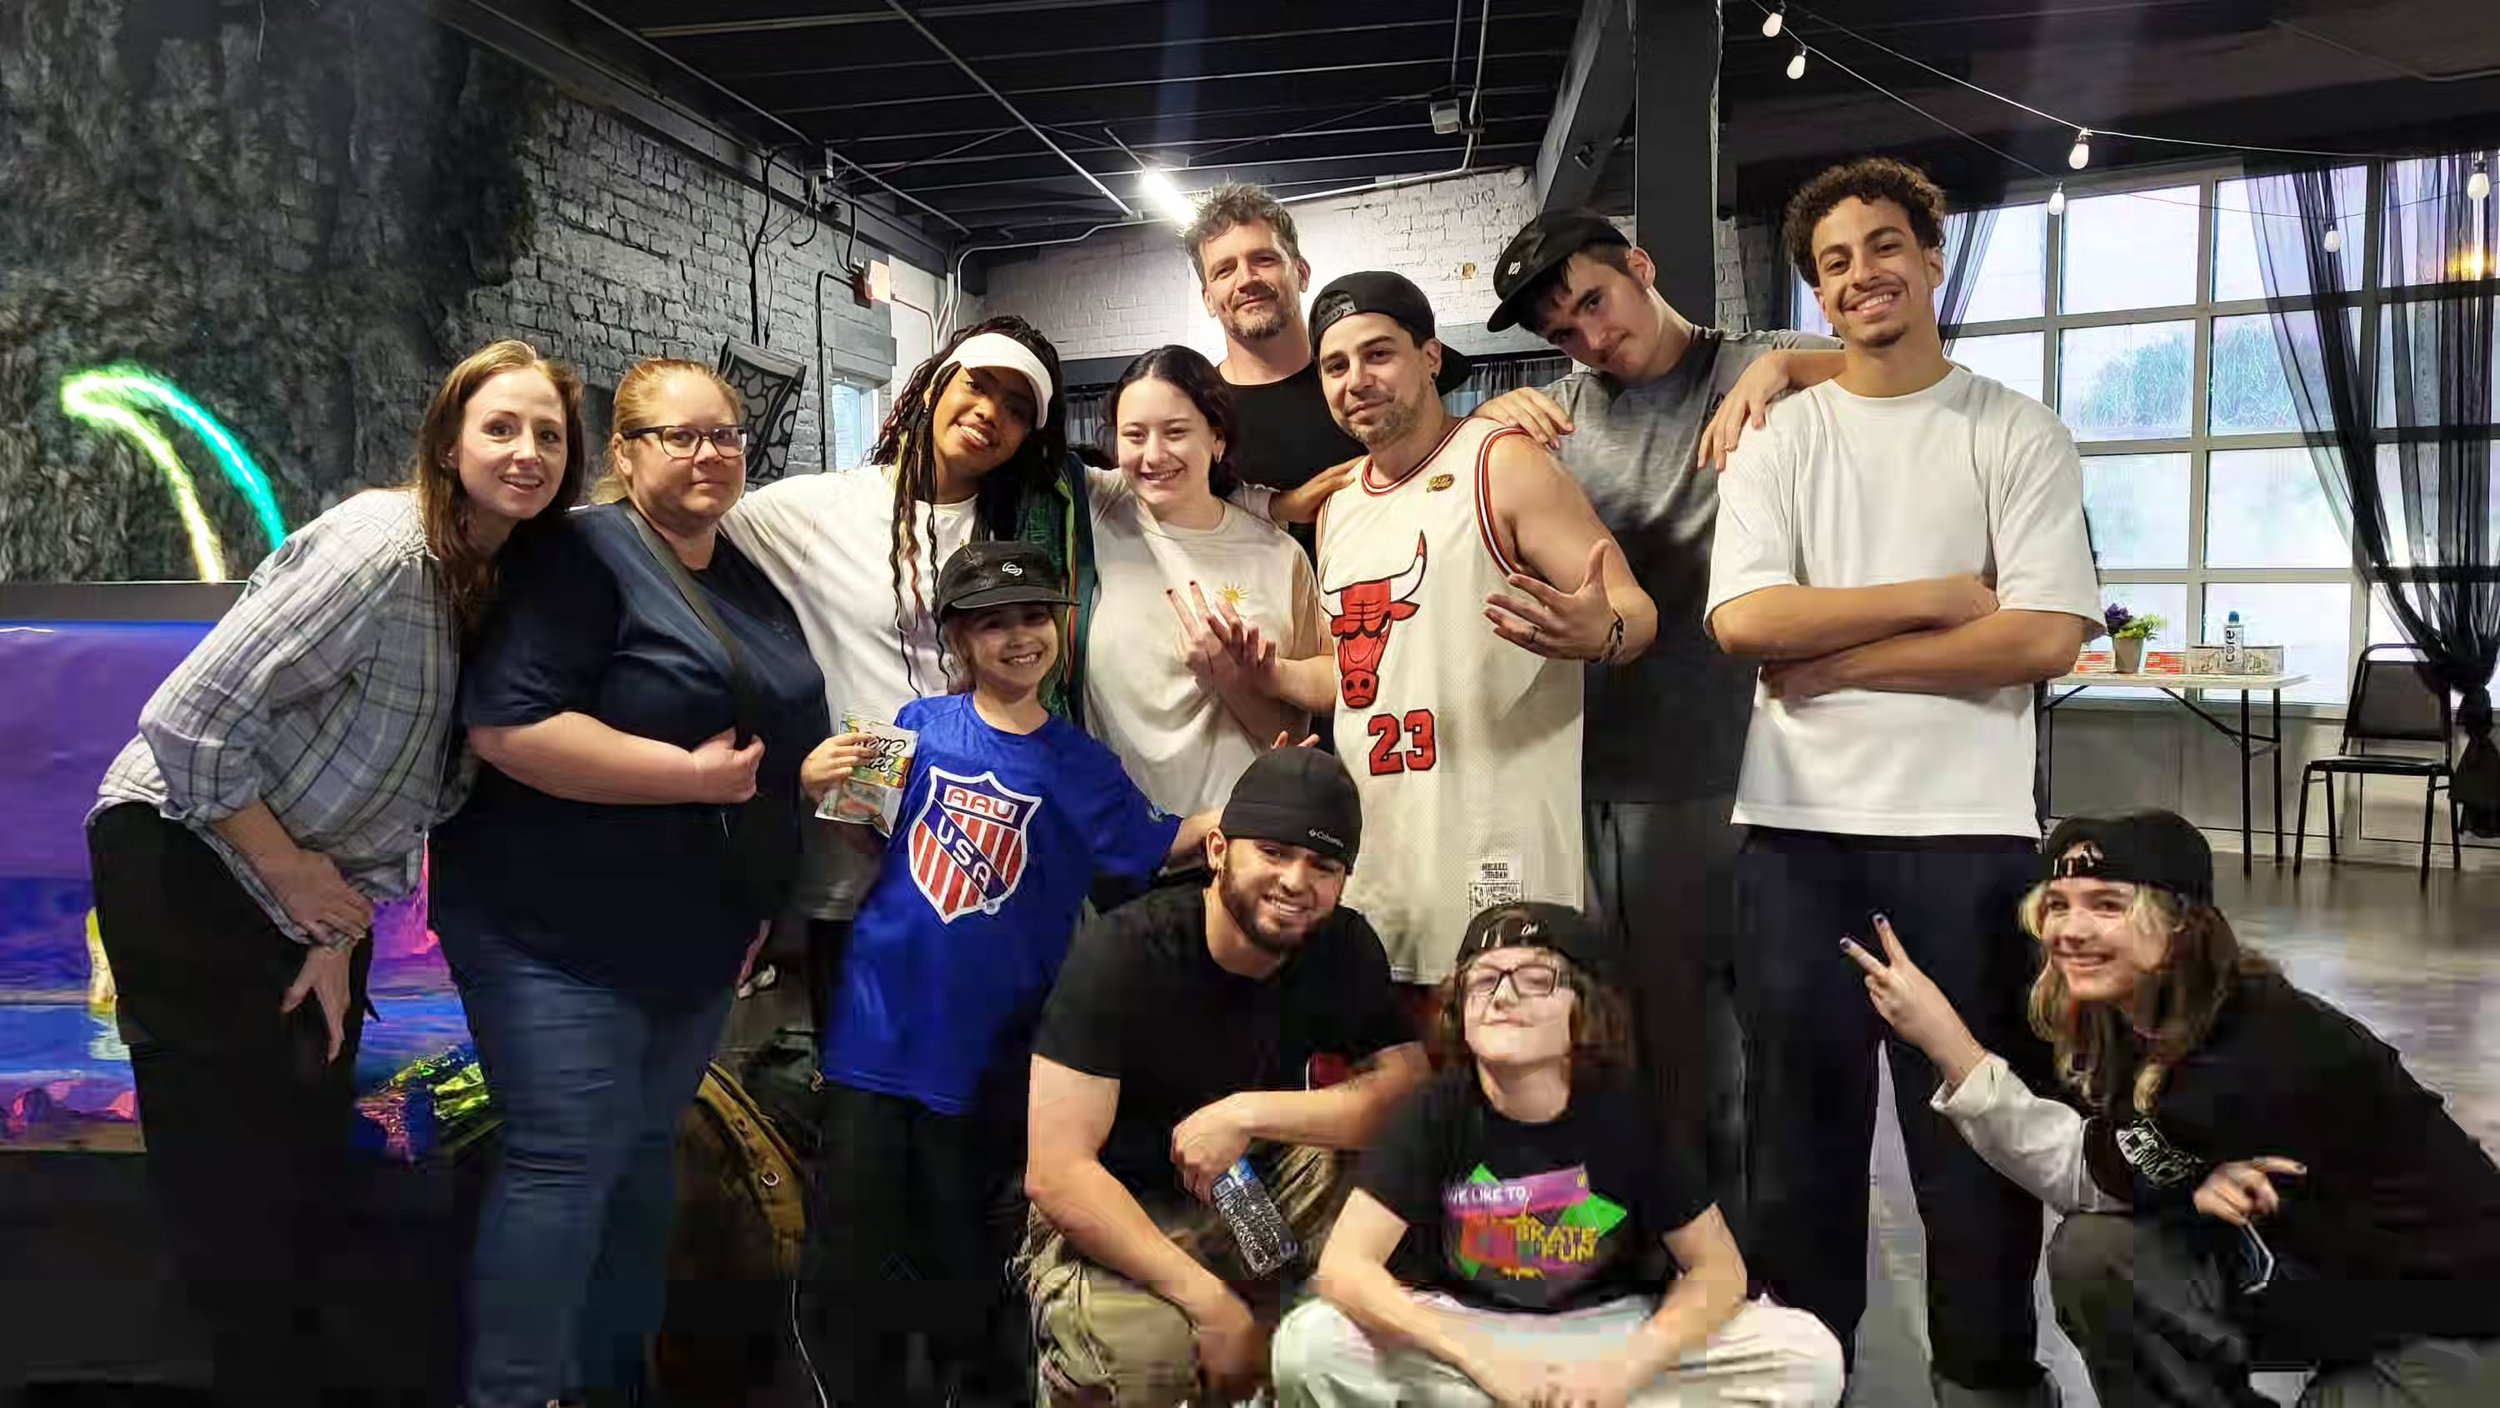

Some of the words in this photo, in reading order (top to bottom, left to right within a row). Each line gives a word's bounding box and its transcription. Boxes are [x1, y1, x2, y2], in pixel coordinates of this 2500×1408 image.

[2225, 630, 2235, 662] core
[1367, 708, 1436, 776] 23
[947, 788, 1014, 819] AAU
[937, 815, 991, 893] USA
[1472, 1187, 1502, 1203] LIKE
